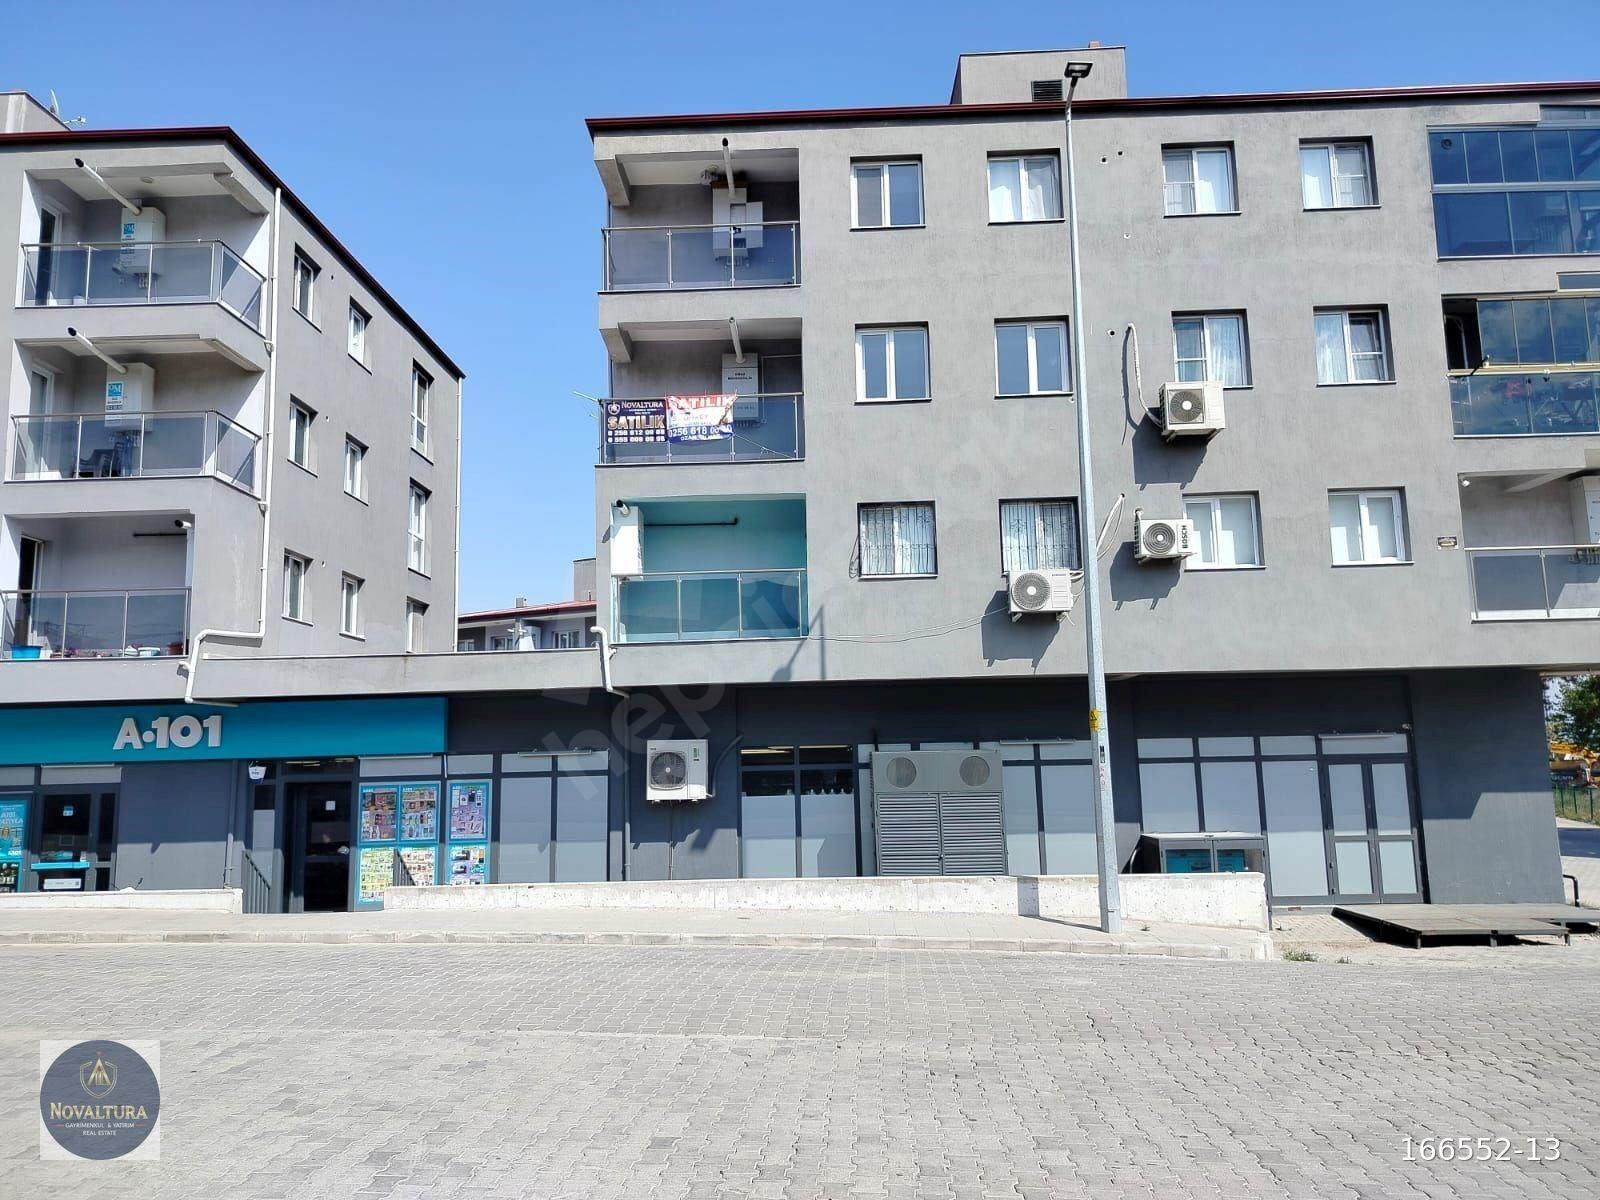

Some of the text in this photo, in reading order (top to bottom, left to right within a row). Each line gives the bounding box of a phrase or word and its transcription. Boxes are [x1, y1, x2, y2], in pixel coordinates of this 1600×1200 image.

[621, 401, 664, 409] NOVALTURA
[607, 415, 665, 430] SATILIK
[1181, 525, 1189, 549] BOSCH
